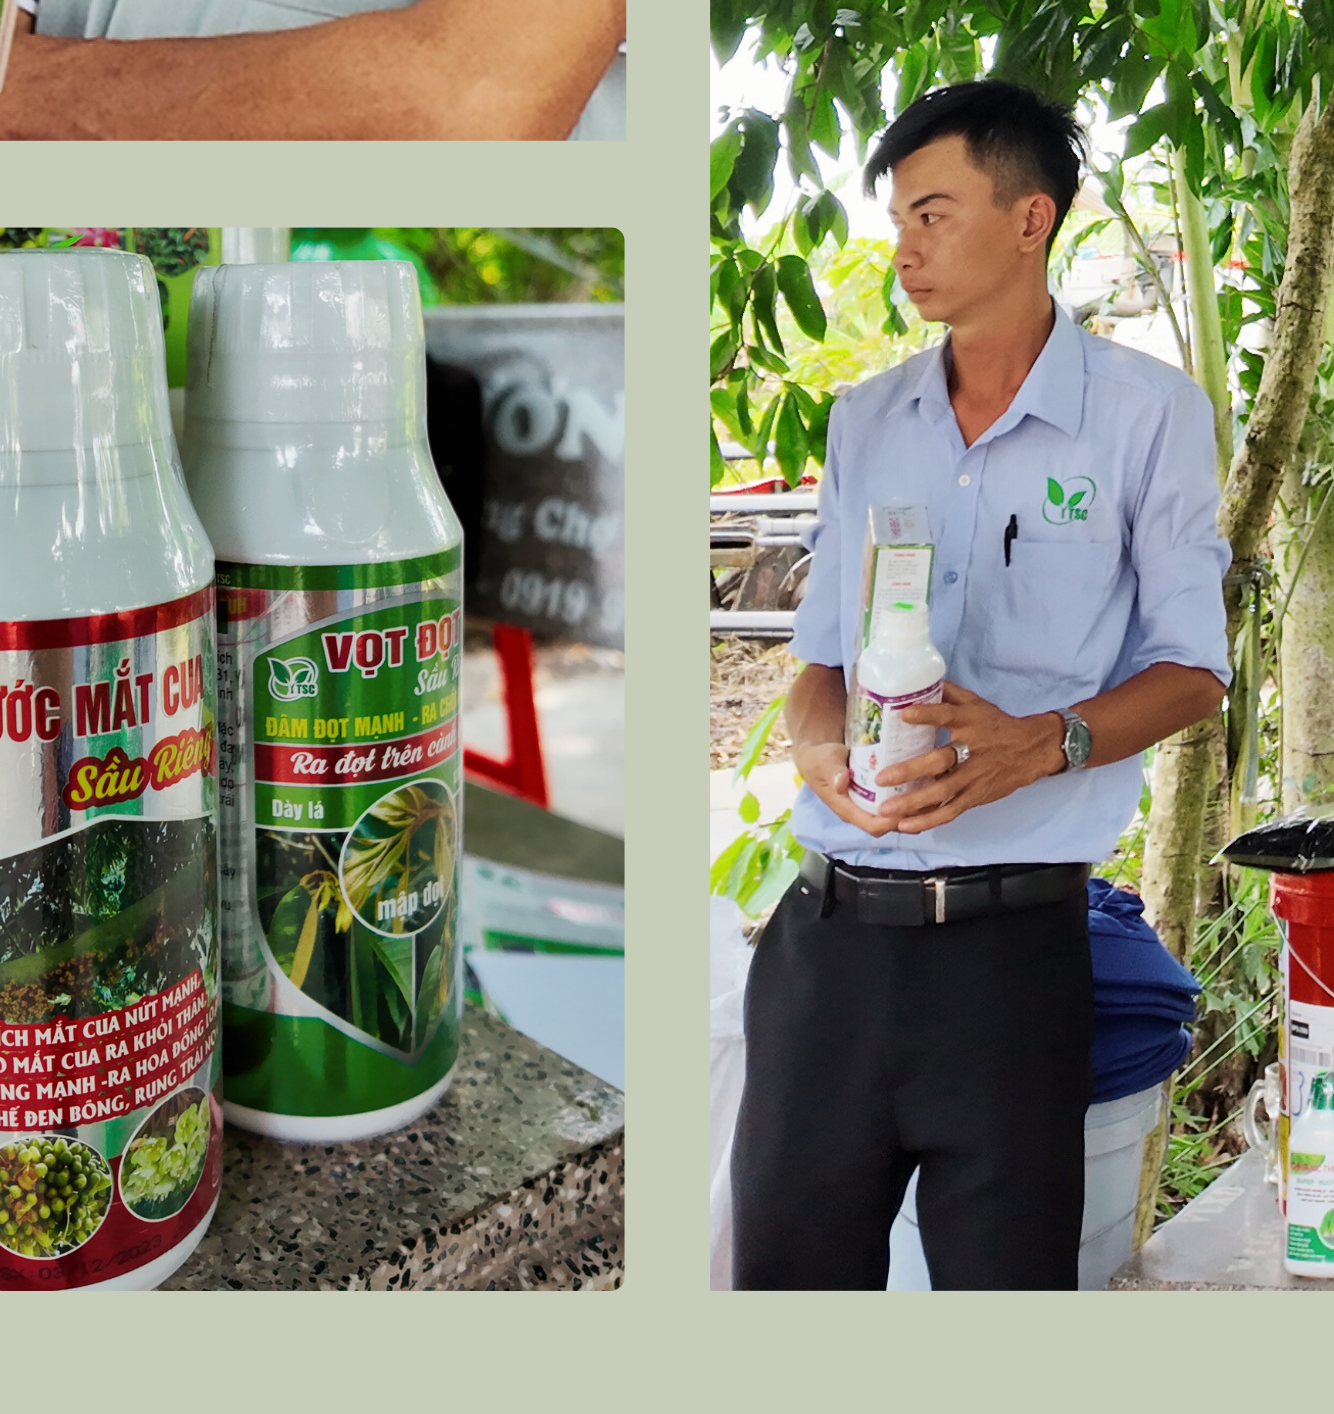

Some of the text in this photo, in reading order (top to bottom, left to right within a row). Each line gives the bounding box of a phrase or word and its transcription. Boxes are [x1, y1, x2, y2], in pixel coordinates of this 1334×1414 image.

[325, 606, 460, 678] VỌT ĐỌT
[73, 657, 154, 737] MẮT
[162, 652, 205, 718] CUA
[414, 663, 448, 696] Sầu
[266, 715, 308, 739] ĐÂM
[313, 717, 351, 743] ĐỌT
[354, 711, 405, 738] MẠNH
[290, 751, 329, 775] Ra
[335, 753, 376, 778] đọt
[382, 742, 423, 769] trên
[70, 725, 214, 804] Sầu Riêng
[271, 798, 325, 819] Dày lá
[377, 891, 419, 922] mập
[13, 1049, 56, 1074] MẮT
[61, 1048, 102, 1070] CUA
[105, 1040, 129, 1061] RA
[133, 1021, 174, 1053] KHỎI
[175, 993, 209, 1031] THÂN,
[35, 1018, 78, 1047] MẮT
[83, 1018, 121, 1039] CUA
[124, 1001, 161, 1028] NỨT
[162, 974, 203, 1013] MẠNH,
[24, 1108, 64, 1127] ĐEN
[69, 1094, 131, 1124] BÔNG,
[134, 1073, 177, 1109] RỤNG
[179, 1053, 204, 1079] TRÁI
[36, 1075, 96, 1102] MẠNH
[135, 1052, 169, 1079] HOA
[171, 1024, 204, 1059] ĐỒNG
